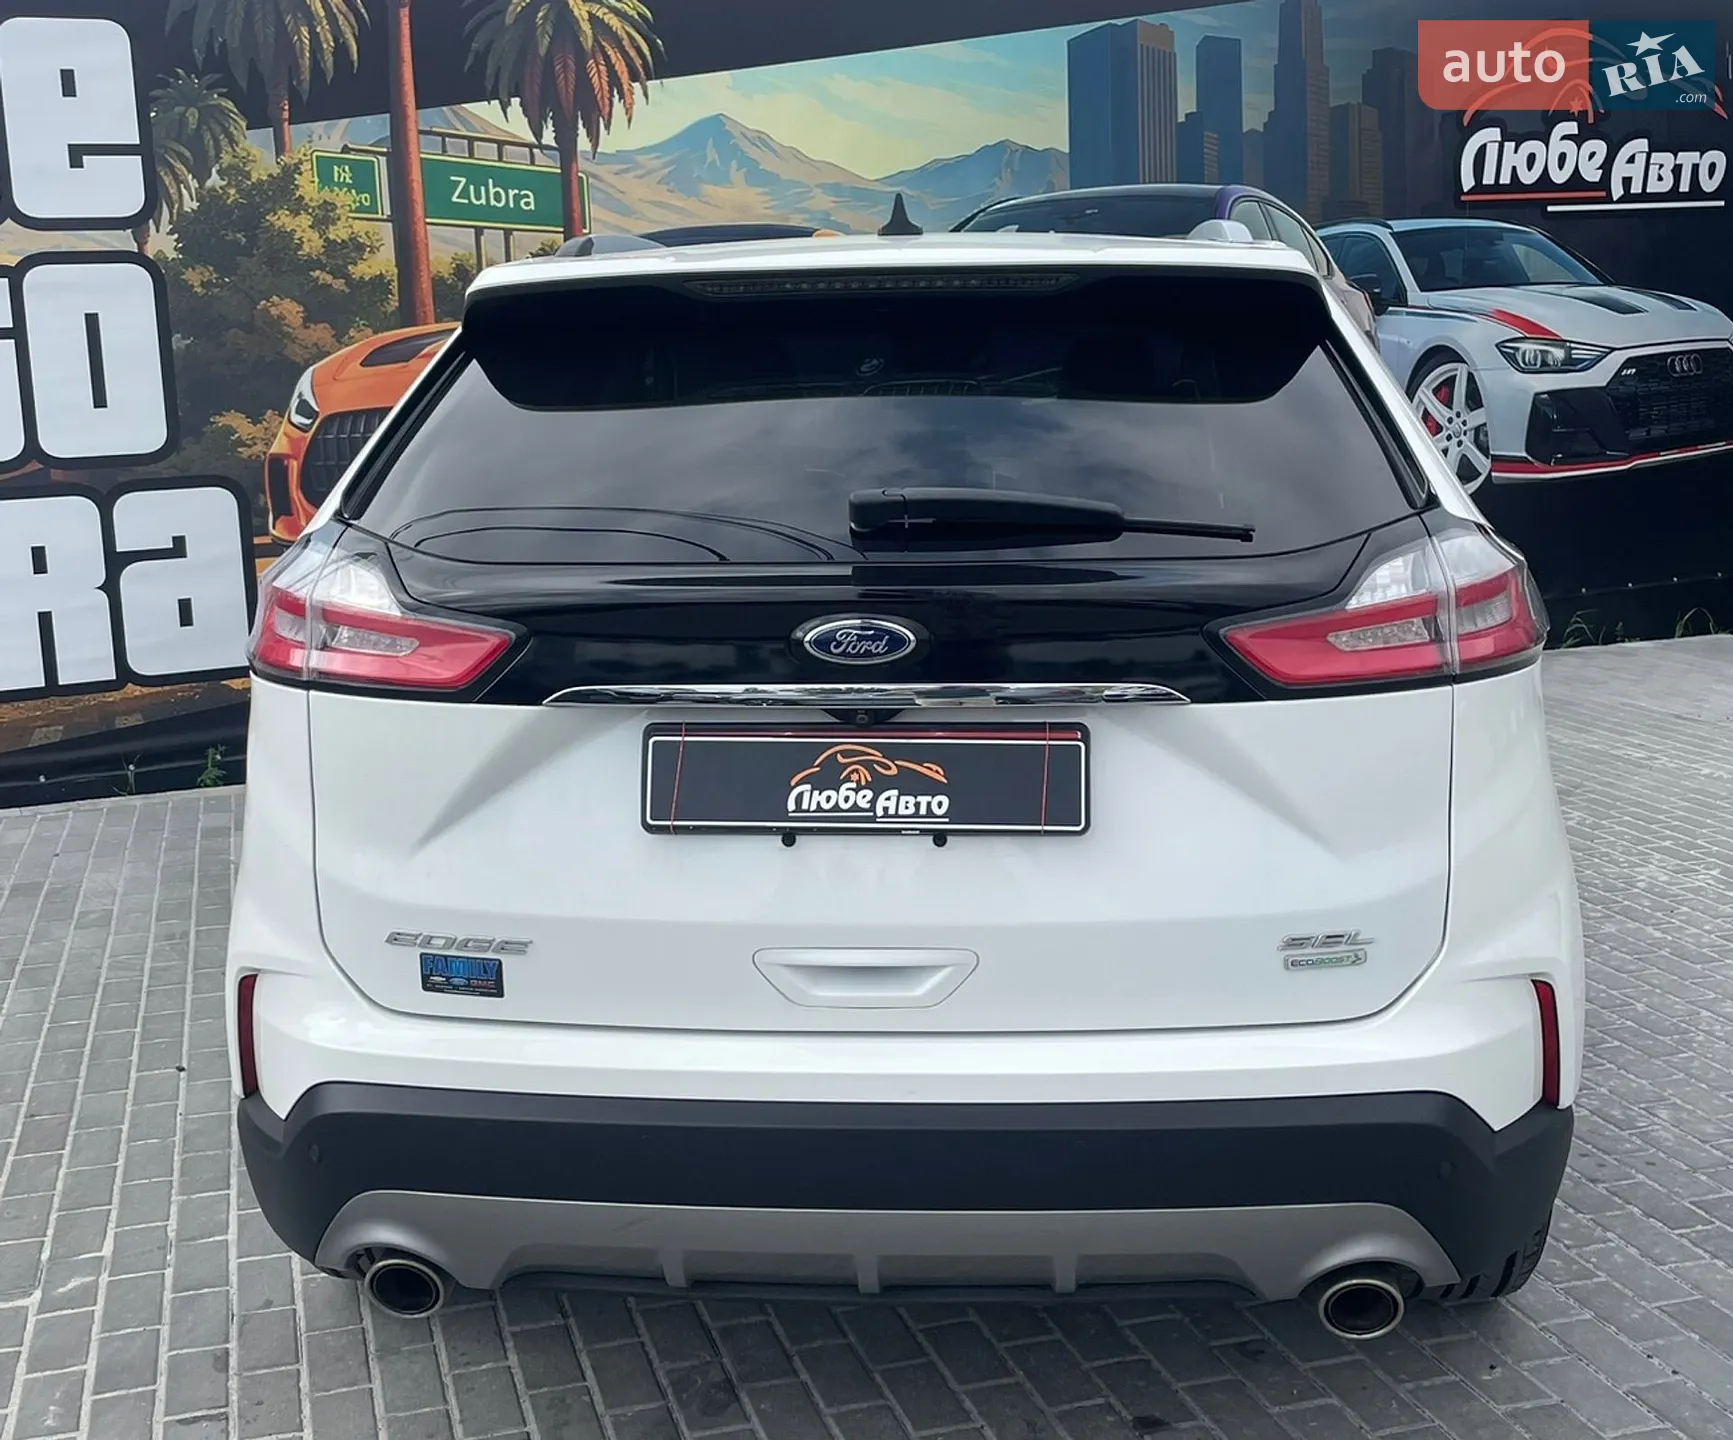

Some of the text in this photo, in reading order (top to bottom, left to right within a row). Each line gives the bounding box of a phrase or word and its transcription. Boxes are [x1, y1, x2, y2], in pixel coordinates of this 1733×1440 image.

[1460, 121, 1608, 193] Любе
[450, 175, 536, 211] Zubra
[830, 629, 890, 654] Ford
[787, 782, 874, 812] Любе
[385, 929, 534, 956] EDGE
[1277, 930, 1375, 951] SEL
[422, 954, 500, 979] FAMILY
